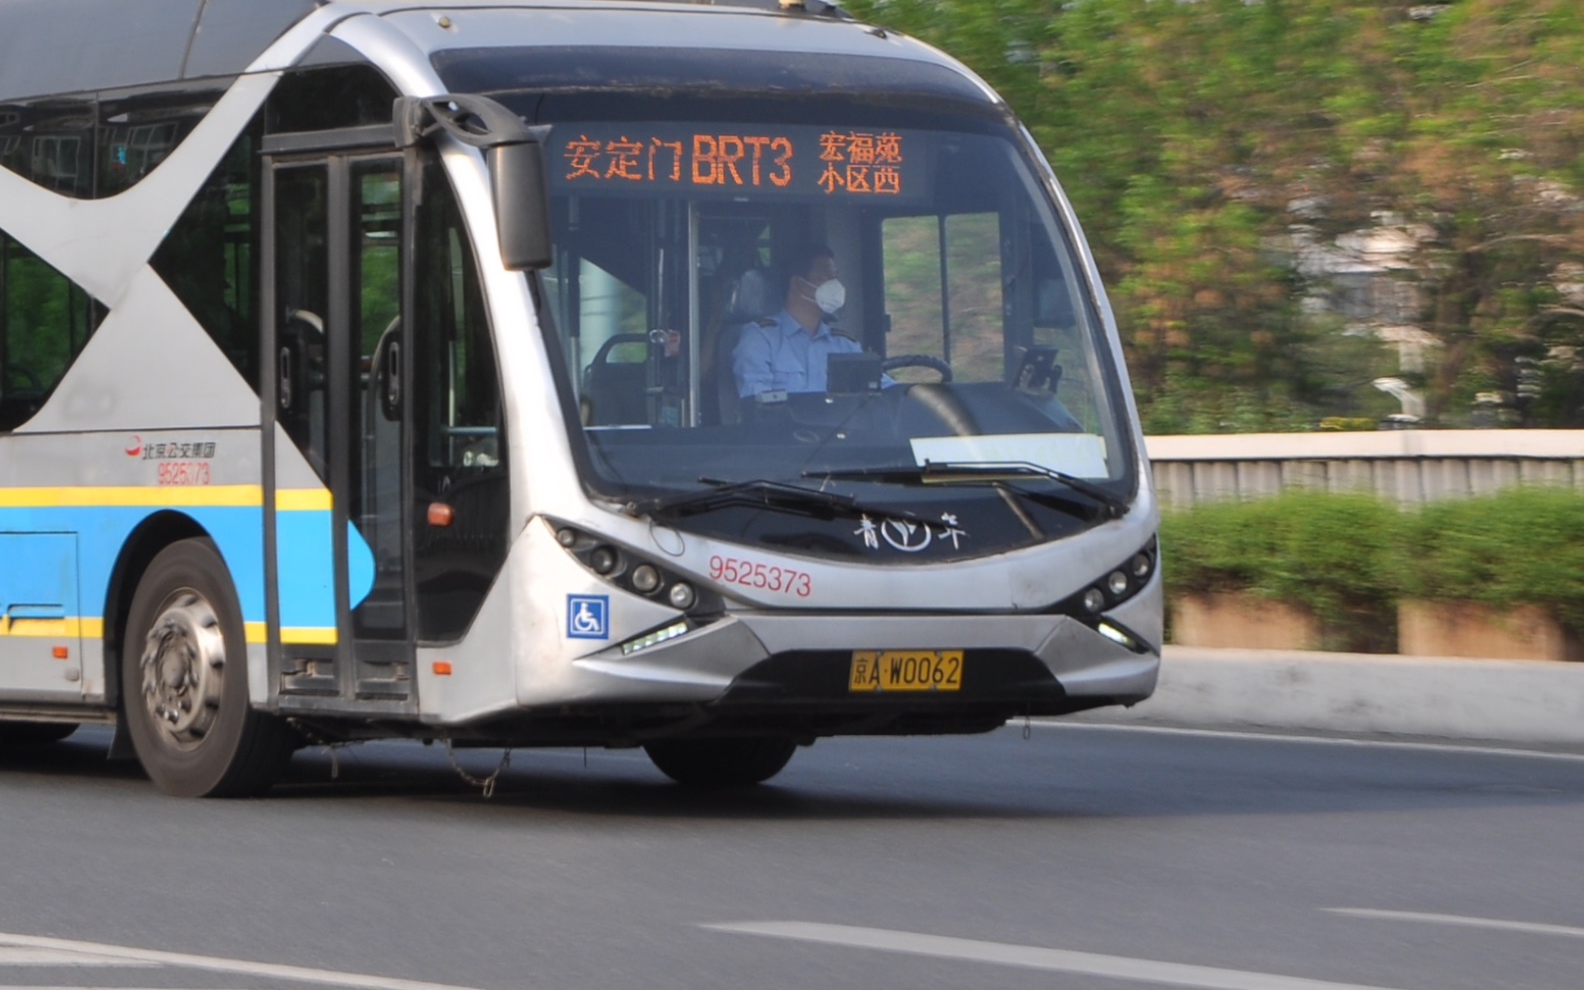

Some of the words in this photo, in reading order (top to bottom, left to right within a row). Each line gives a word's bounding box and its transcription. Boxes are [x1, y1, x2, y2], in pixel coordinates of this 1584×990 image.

[563, 134, 683, 182] 安定门
[692, 134, 794, 187] BRT3
[818, 130, 903, 164] 宏福苑
[817, 164, 901, 195] 小区西
[142, 442, 216, 460] 北京公交集团
[709, 555, 812, 598] 9525373
